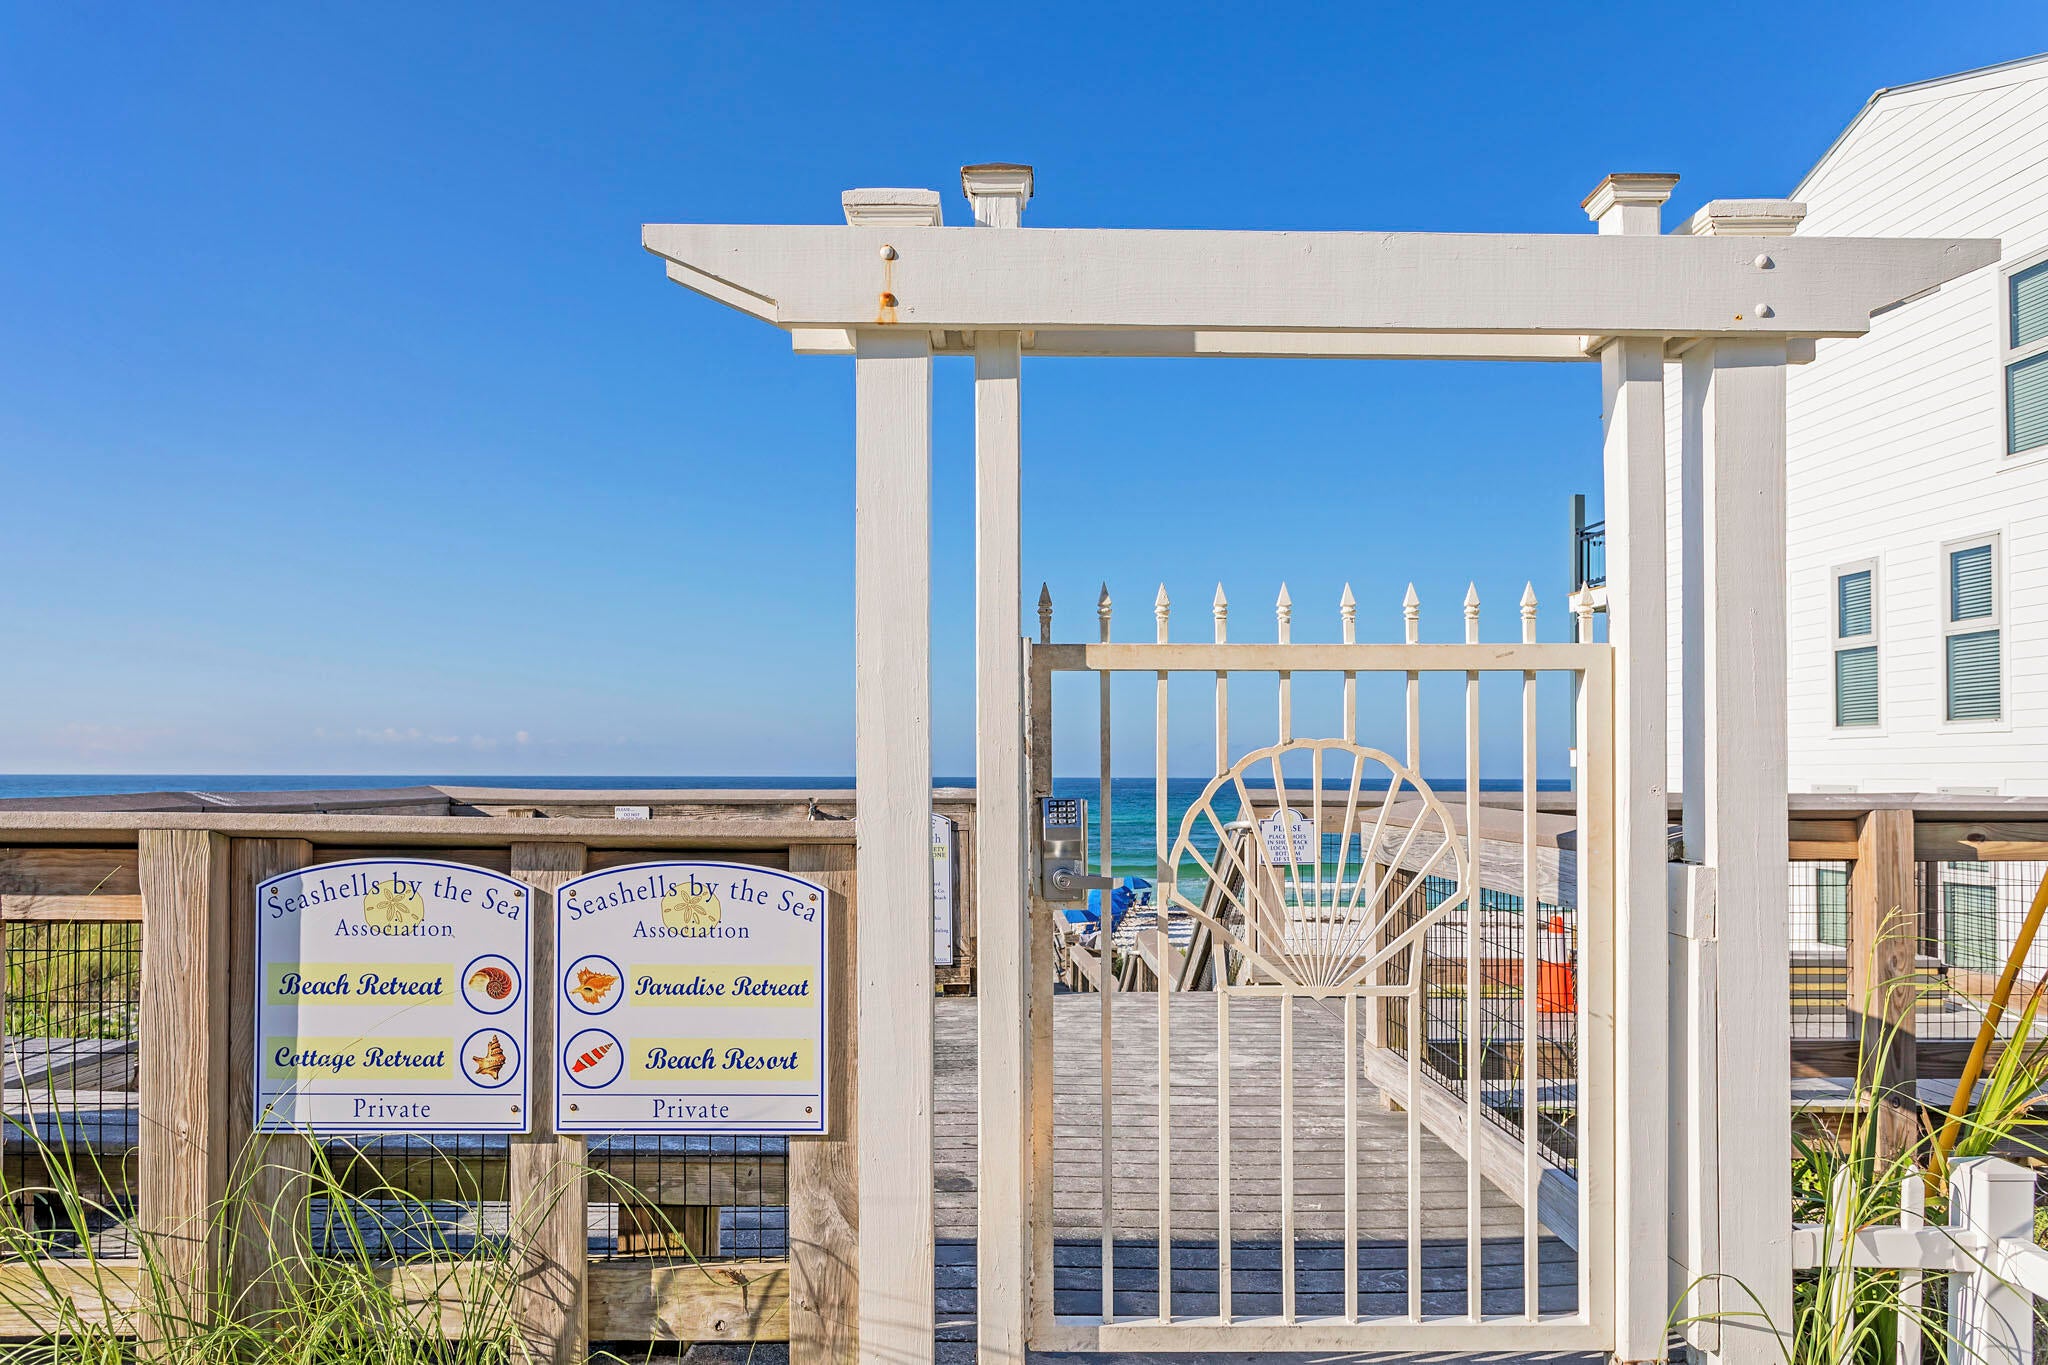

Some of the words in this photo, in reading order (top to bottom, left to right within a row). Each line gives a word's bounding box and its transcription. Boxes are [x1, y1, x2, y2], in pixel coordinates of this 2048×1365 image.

[1273, 824, 1302, 832] PLSE
[267, 871, 381, 919] Seashells
[392, 871, 423, 901] by
[433, 876, 473, 903] the
[481, 887, 521, 921] Sea
[566, 874, 678, 921] Seashells
[688, 873, 720, 903] by
[730, 877, 769, 906] the
[777, 889, 816, 923] Sea
[334, 918, 453, 938] Association
[632, 919, 750, 939] Association
[278, 972, 351, 996] Beach
[356, 973, 444, 996] Retreat
[634, 975, 726, 997] Paradise
[731, 976, 810, 997] Retreat
[274, 1046, 356, 1075] Cottage
[362, 1047, 446, 1069] Retreat
[644, 1047, 717, 1071] Beach
[721, 1047, 799, 1070] Resort
[352, 1097, 432, 1119] Private
[652, 1098, 730, 1119] Private
